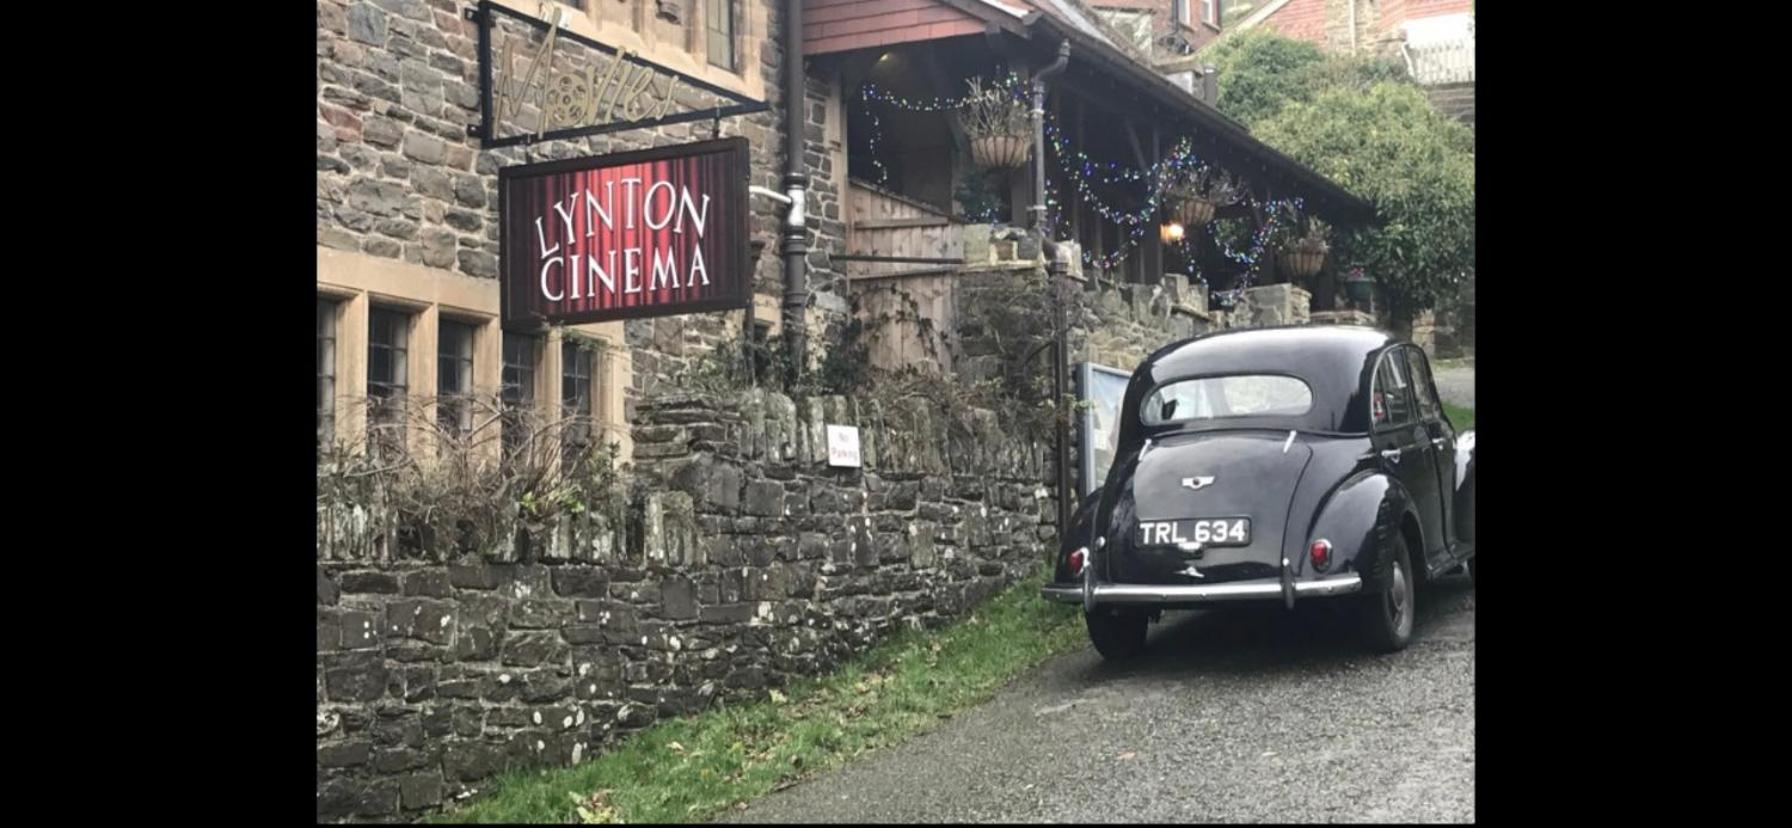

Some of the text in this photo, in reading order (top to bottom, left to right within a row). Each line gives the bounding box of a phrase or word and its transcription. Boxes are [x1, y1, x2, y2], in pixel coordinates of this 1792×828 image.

[535, 177, 710, 259] LYNTON
[541, 242, 710, 301] CINEMA
[1139, 520, 1245, 545] TRL 634
